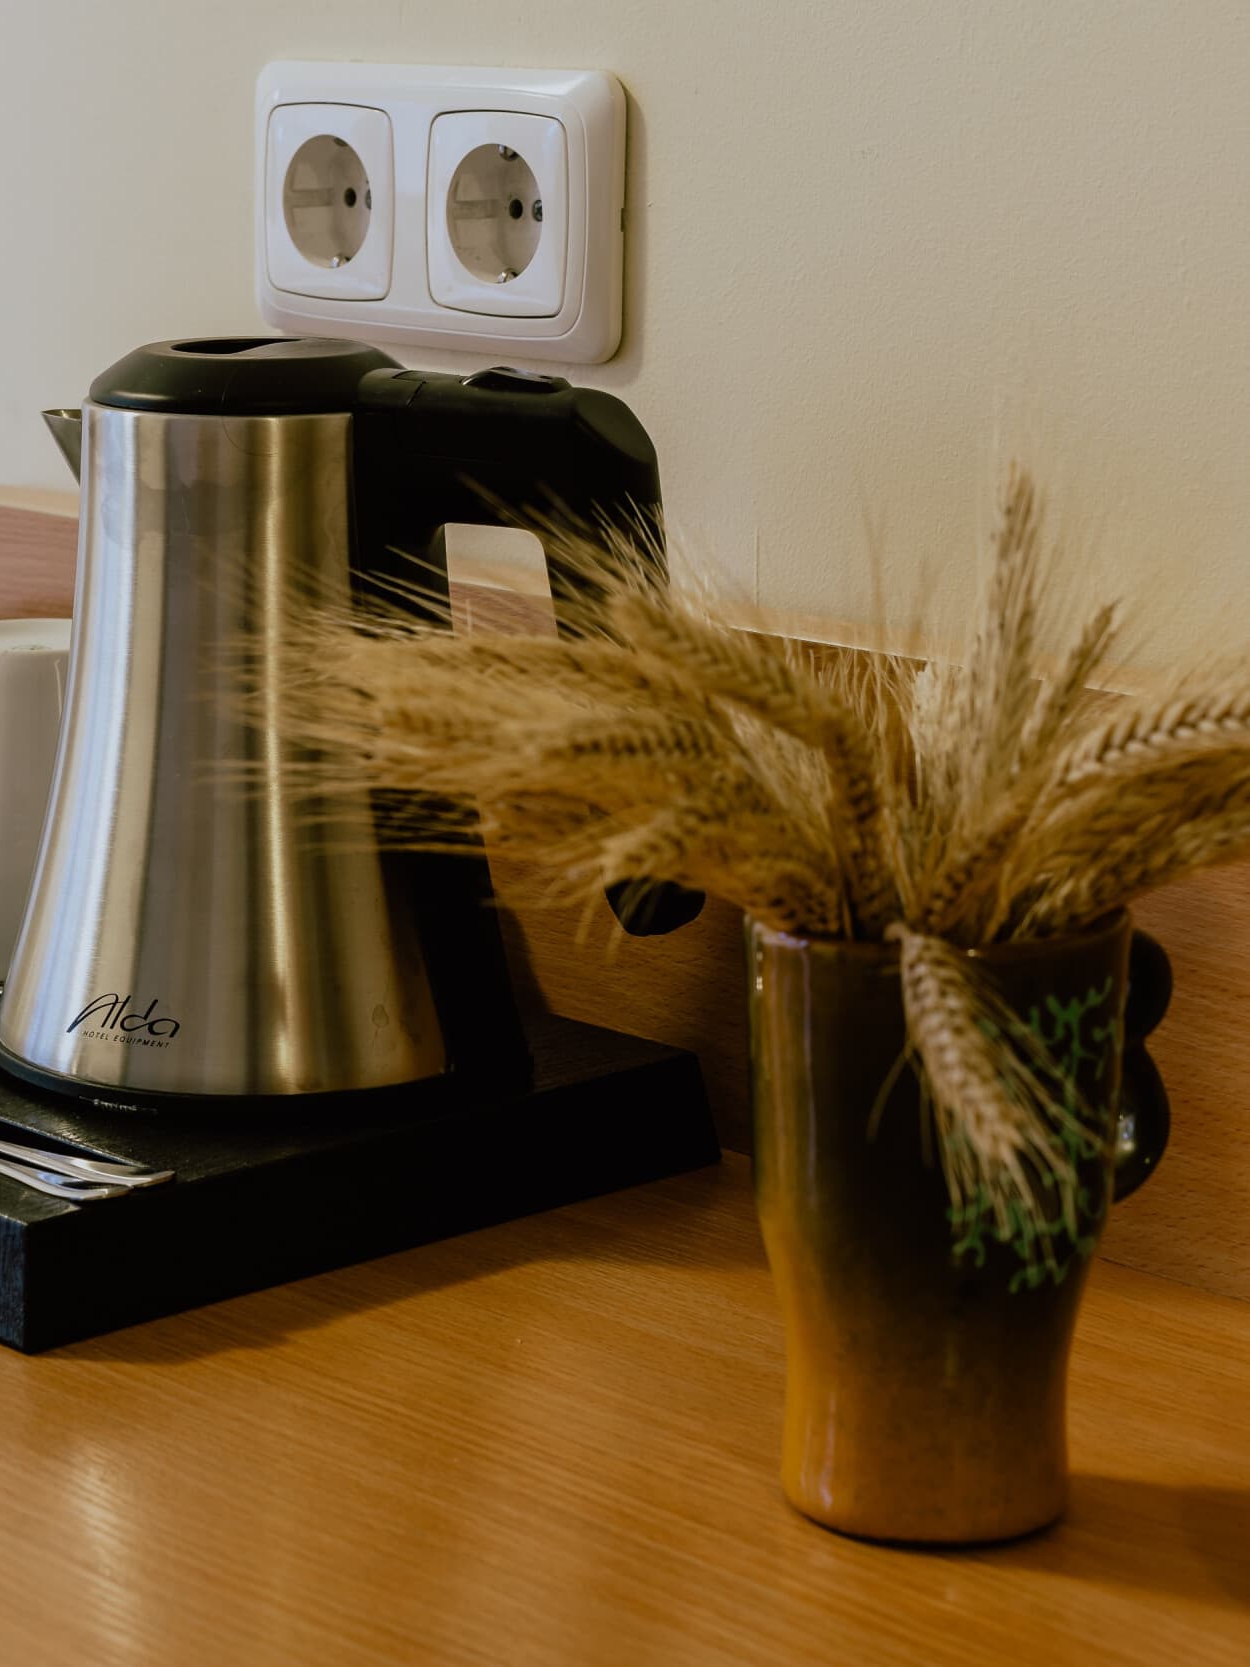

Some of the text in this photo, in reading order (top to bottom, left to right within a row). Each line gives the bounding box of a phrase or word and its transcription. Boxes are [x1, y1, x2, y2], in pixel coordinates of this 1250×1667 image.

[66, 993, 180, 1038] Alda
[82, 1030, 170, 1048] HOTEL EQUIPMENT
